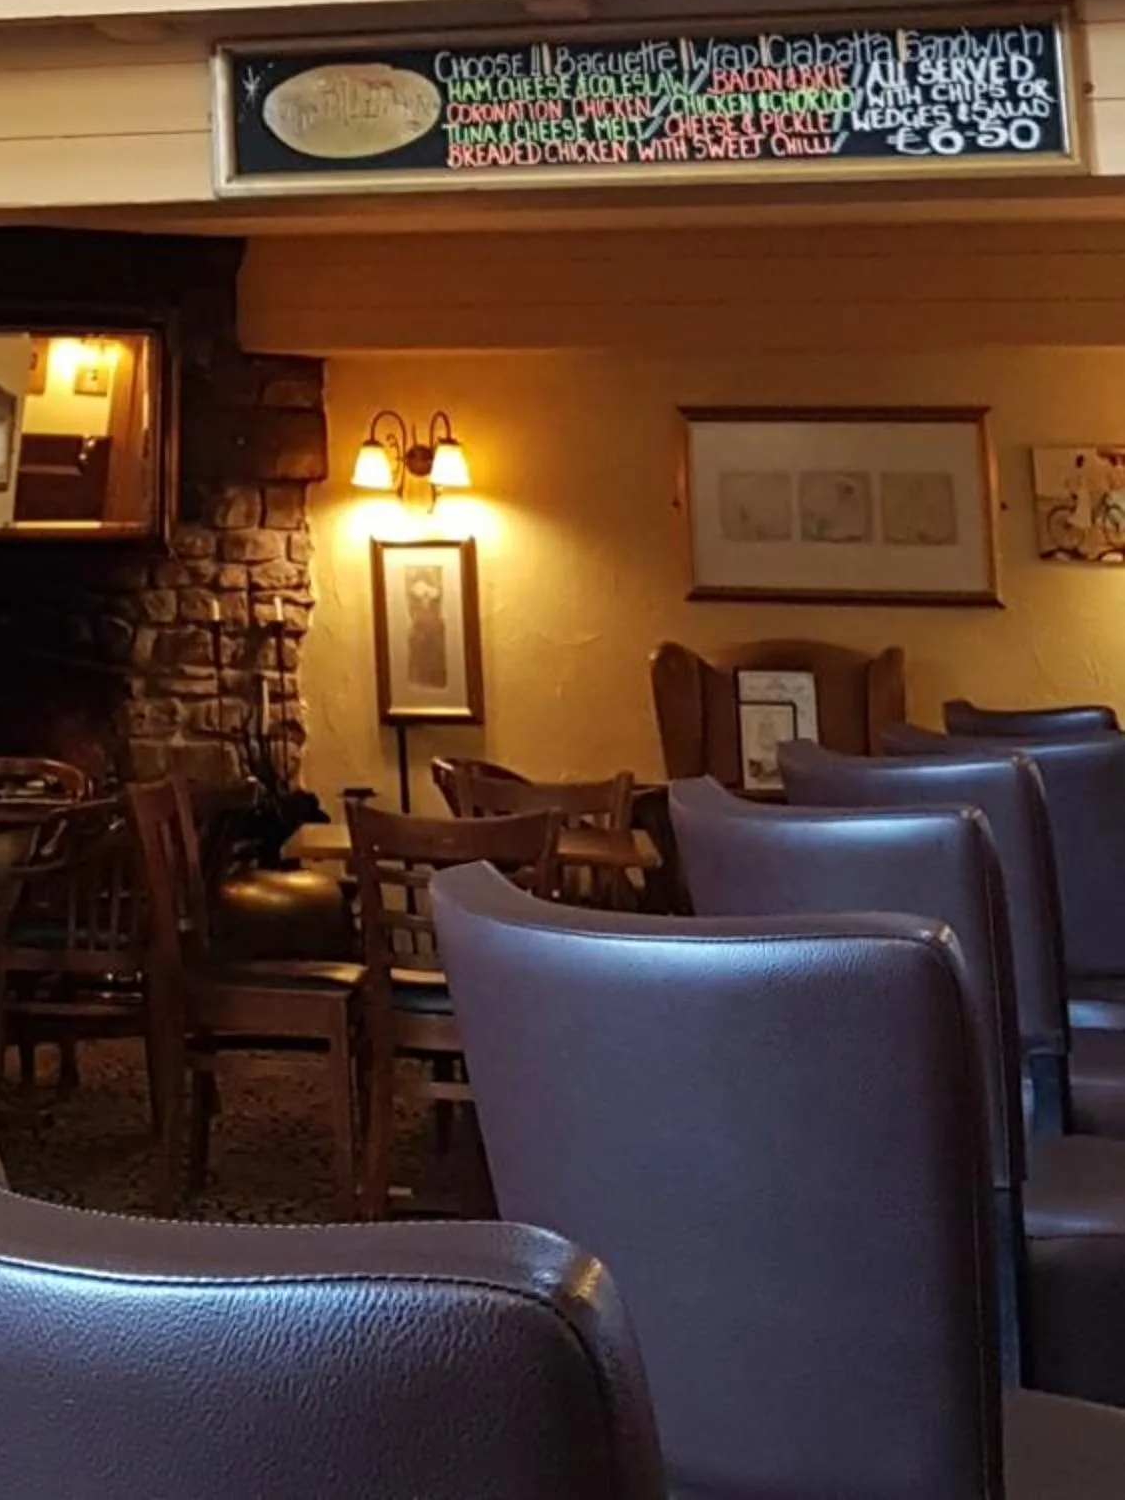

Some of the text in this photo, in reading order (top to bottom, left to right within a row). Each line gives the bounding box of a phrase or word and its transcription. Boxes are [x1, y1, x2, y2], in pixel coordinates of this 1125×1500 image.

[768, 29, 892, 68] Ciabatta
[906, 26, 1043, 62] Sandwich
[709, 67, 783, 94] BACON
[801, 64, 848, 90] BRIE
[917, 55, 1035, 84] SERVED
[931, 82, 1007, 102] CHIPS
[1016, 79, 1055, 103] OR
[447, 100, 562, 124] CORONATION
[573, 96, 651, 120] CHICKEN
[670, 92, 754, 114] CHICKEN
[851, 105, 952, 131] WEDGES
[971, 98, 1050, 124] SALAD
[442, 122, 497, 143] TUNA
[513, 119, 588, 142] CHEESE
[594, 117, 647, 141] MELT
[665, 113, 739, 136] CHEESE
[761, 110, 833, 134] PICKLE
[447, 143, 541, 168] BREADED
[545, 140, 630, 164] CHICKEN
[636, 136, 688, 161] WITH
[693, 134, 764, 159] SWEET
